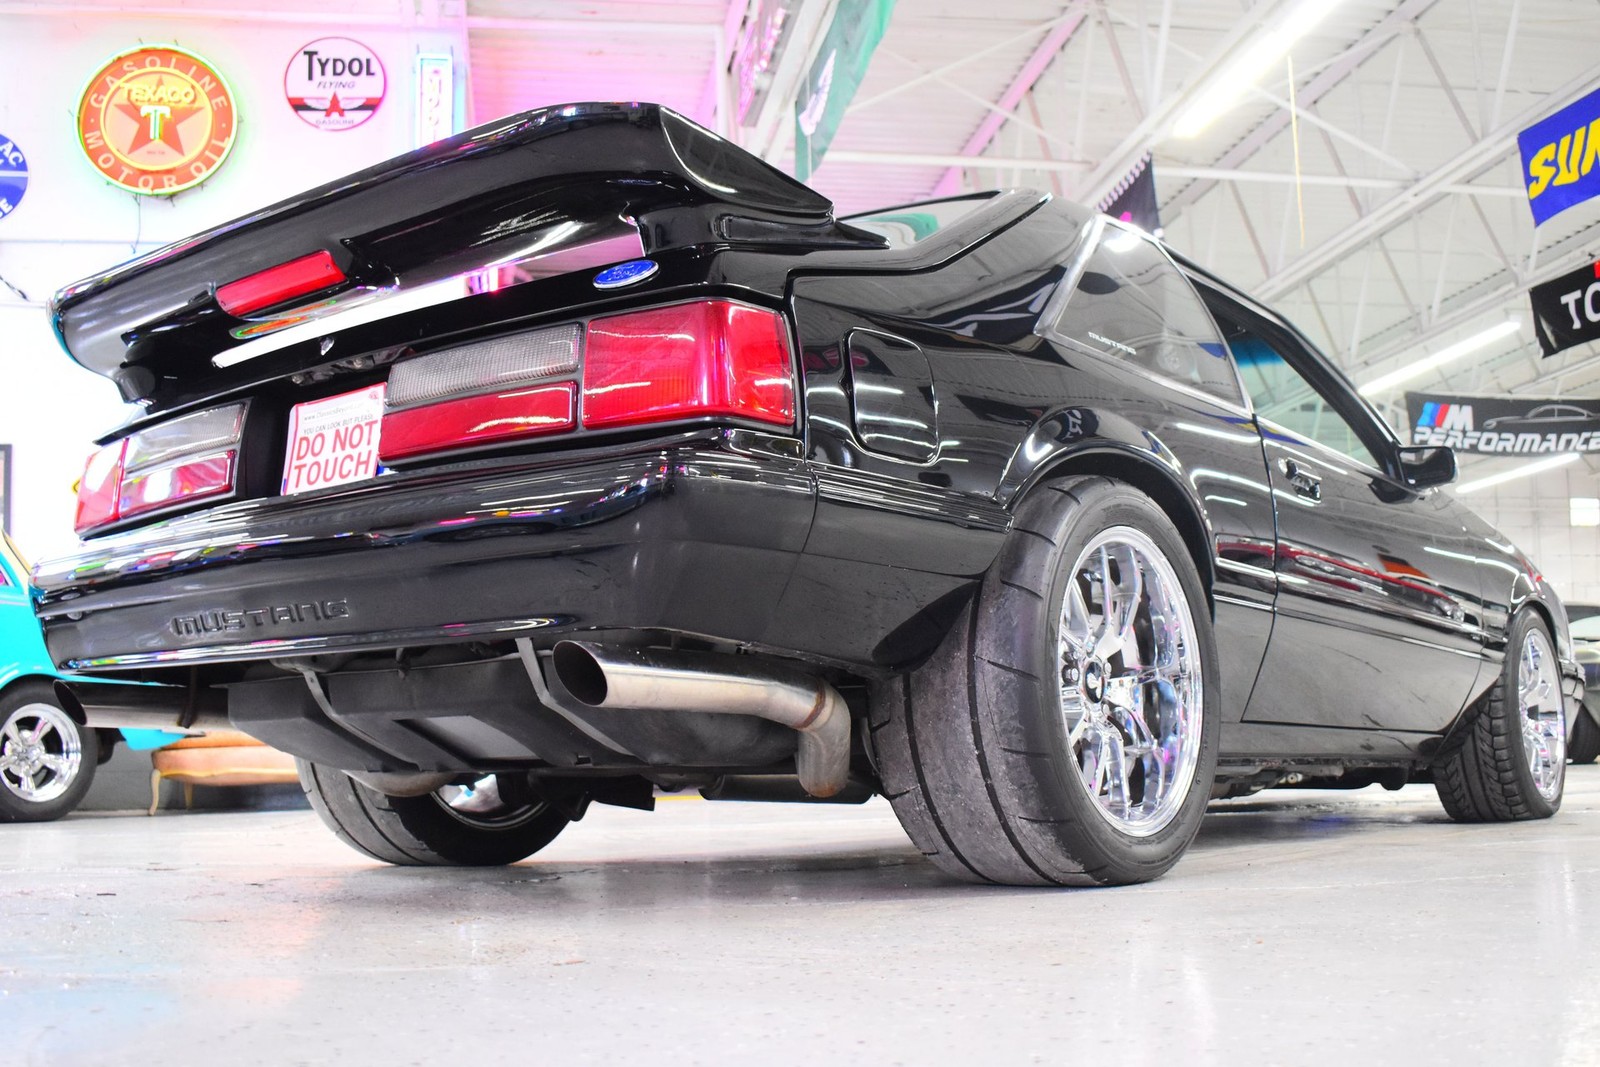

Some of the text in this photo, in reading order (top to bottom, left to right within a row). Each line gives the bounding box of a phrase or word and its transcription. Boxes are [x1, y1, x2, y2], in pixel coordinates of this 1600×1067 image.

[303, 50, 375, 81] TYDOL
[90, 56, 228, 110] GASOLINE
[120, 83, 197, 106] TEXACO
[316, 81, 356, 89] FLYING
[140, 105, 171, 141] T
[85, 130, 231, 190] MOTOR OIL
[303, 413, 374, 436] YOU CAN LOOK BUT PLEASE
[1443, 404, 1474, 431] M
[296, 420, 379, 461] DO NOT
[1414, 426, 1600, 454] PERFORMANCE
[294, 449, 372, 489] TOUCH
[171, 599, 349, 636] MUSTANG
